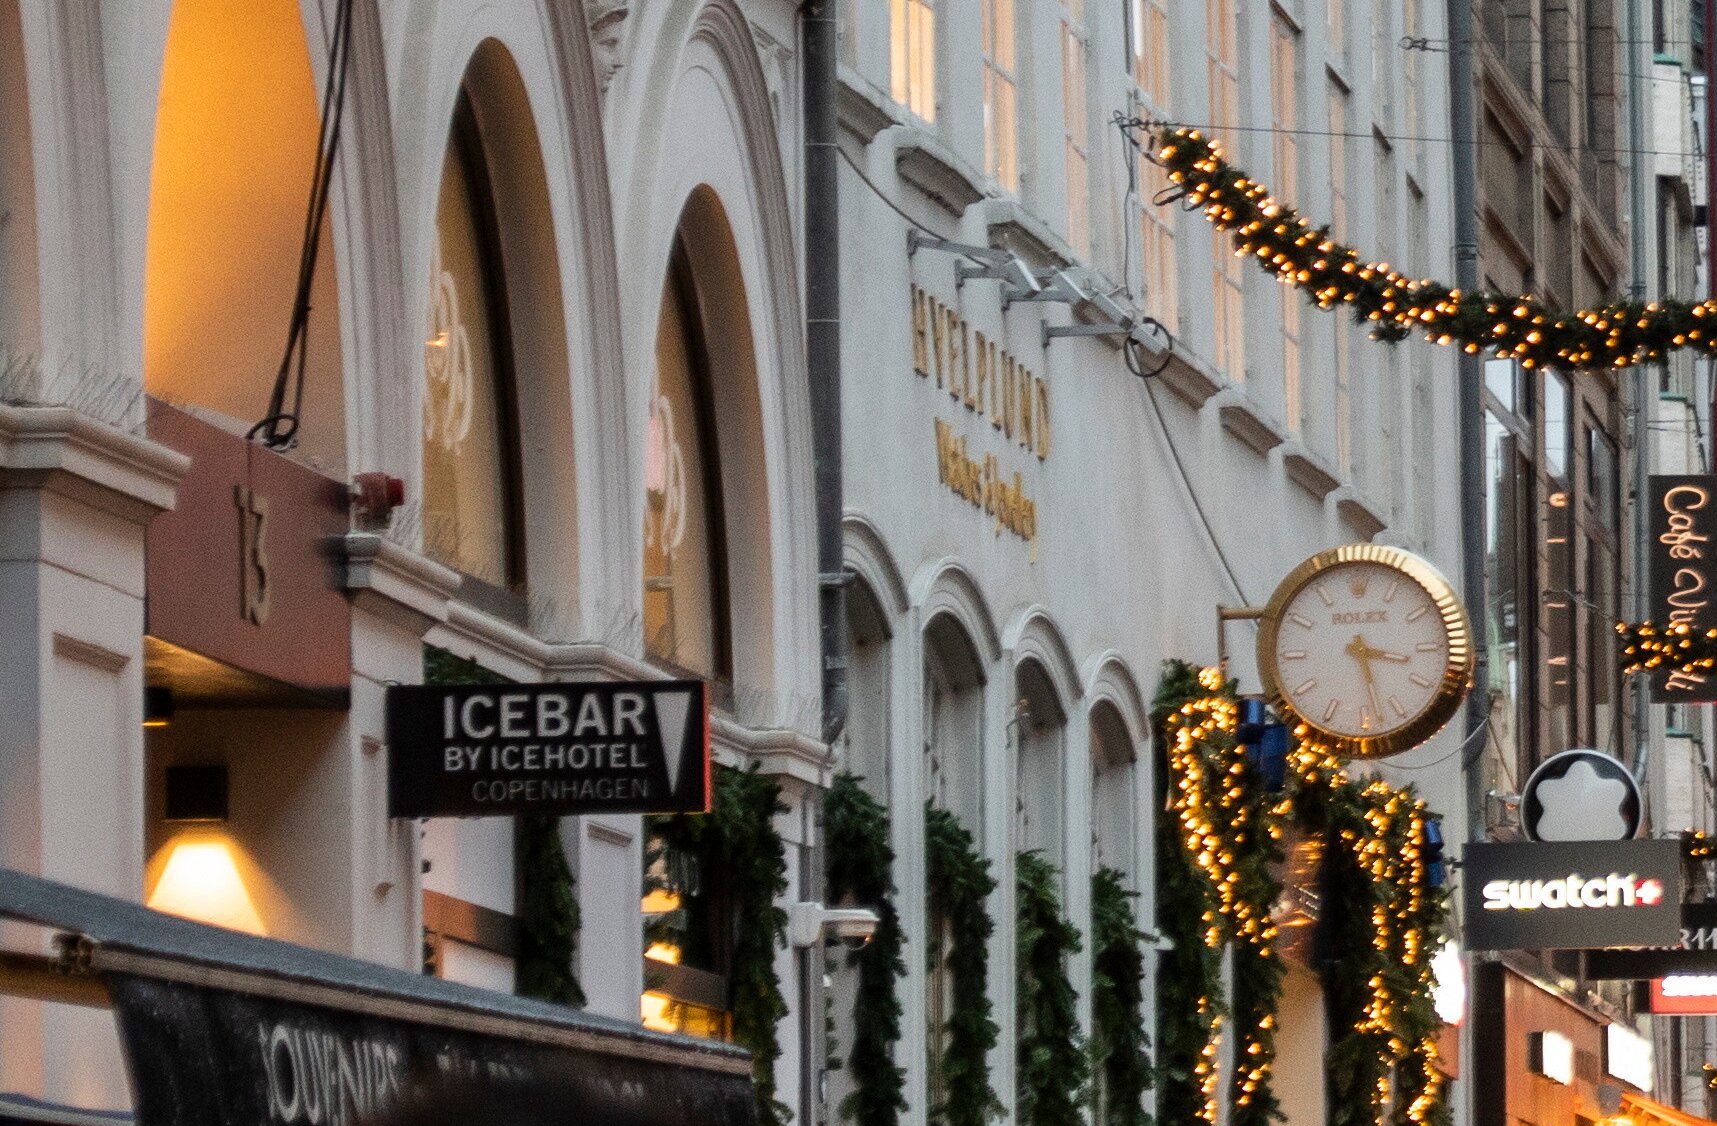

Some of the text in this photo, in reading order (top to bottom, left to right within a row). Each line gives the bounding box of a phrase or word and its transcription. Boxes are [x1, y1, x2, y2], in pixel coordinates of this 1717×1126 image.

[1660, 486, 1709, 559] Café
[1332, 612, 1388, 625] ROLEX
[443, 692, 648, 739] ICEBAR
[444, 743, 648, 771] BY ICEHOTEL
[471, 779, 648, 802] COPENHAGEN
